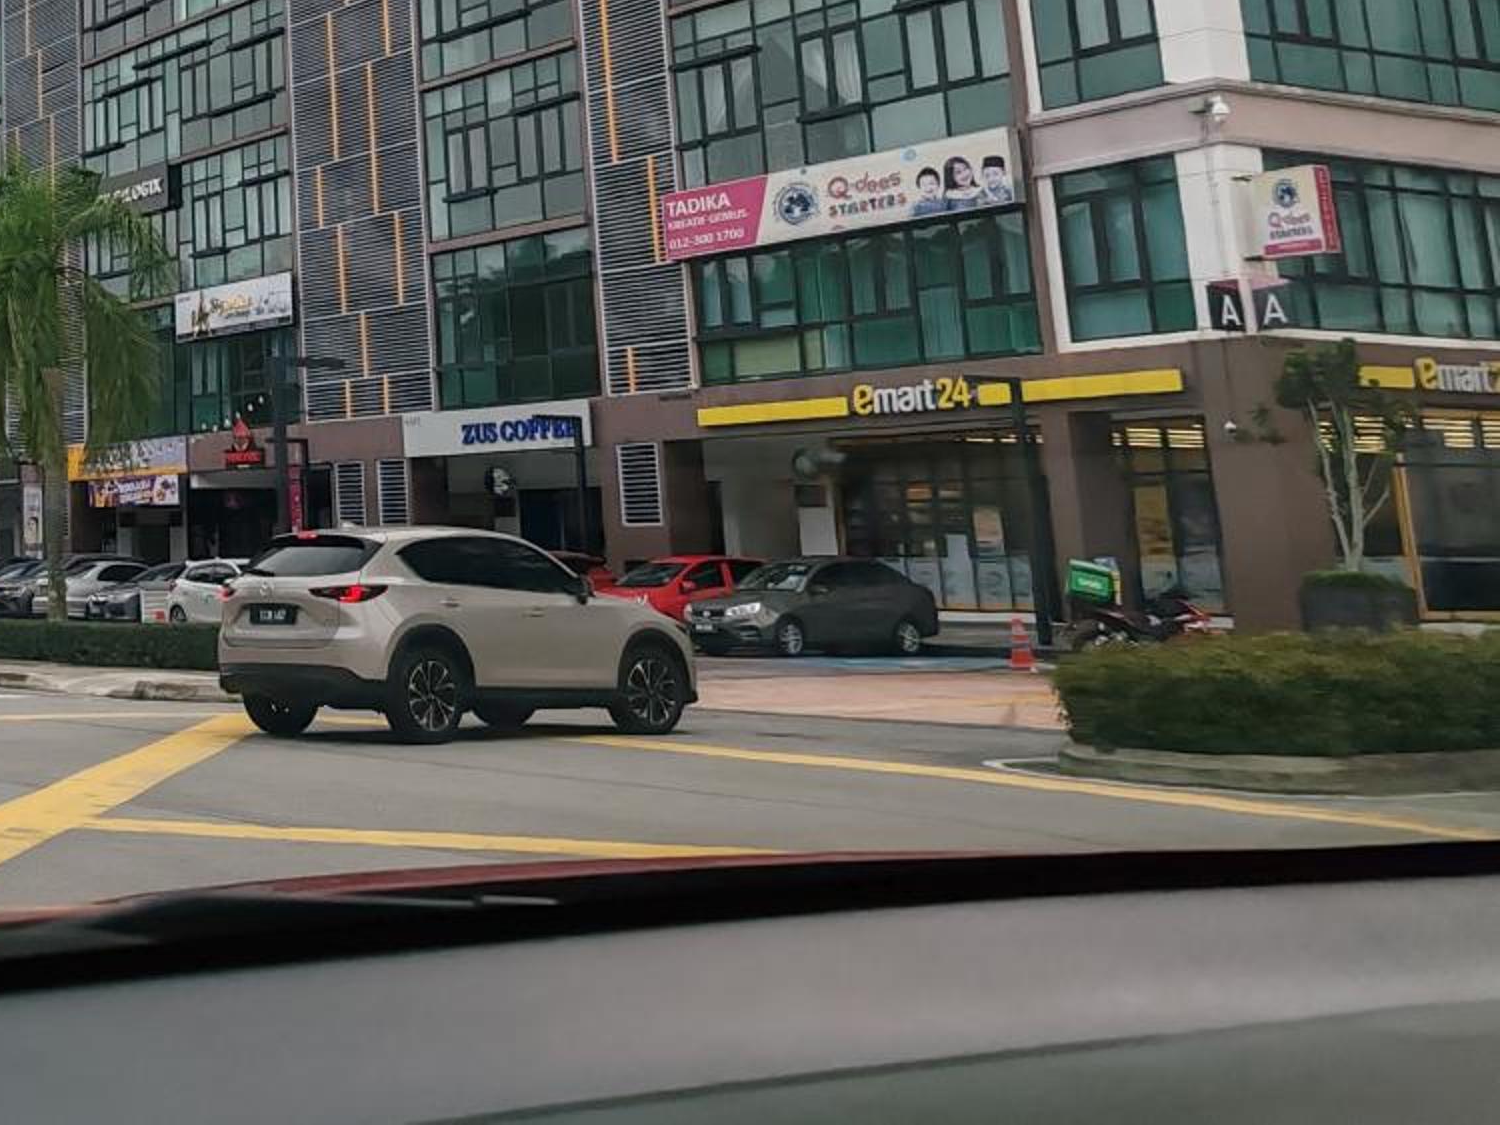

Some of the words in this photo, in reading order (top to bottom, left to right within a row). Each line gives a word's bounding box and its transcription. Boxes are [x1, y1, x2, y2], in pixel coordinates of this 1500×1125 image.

[666, 192, 731, 217] TADIKA
[1221, 294, 1242, 325] A
[1263, 293, 1288, 325] A
[853, 376, 971, 415] emart24
[461, 423, 499, 444] ZUS
